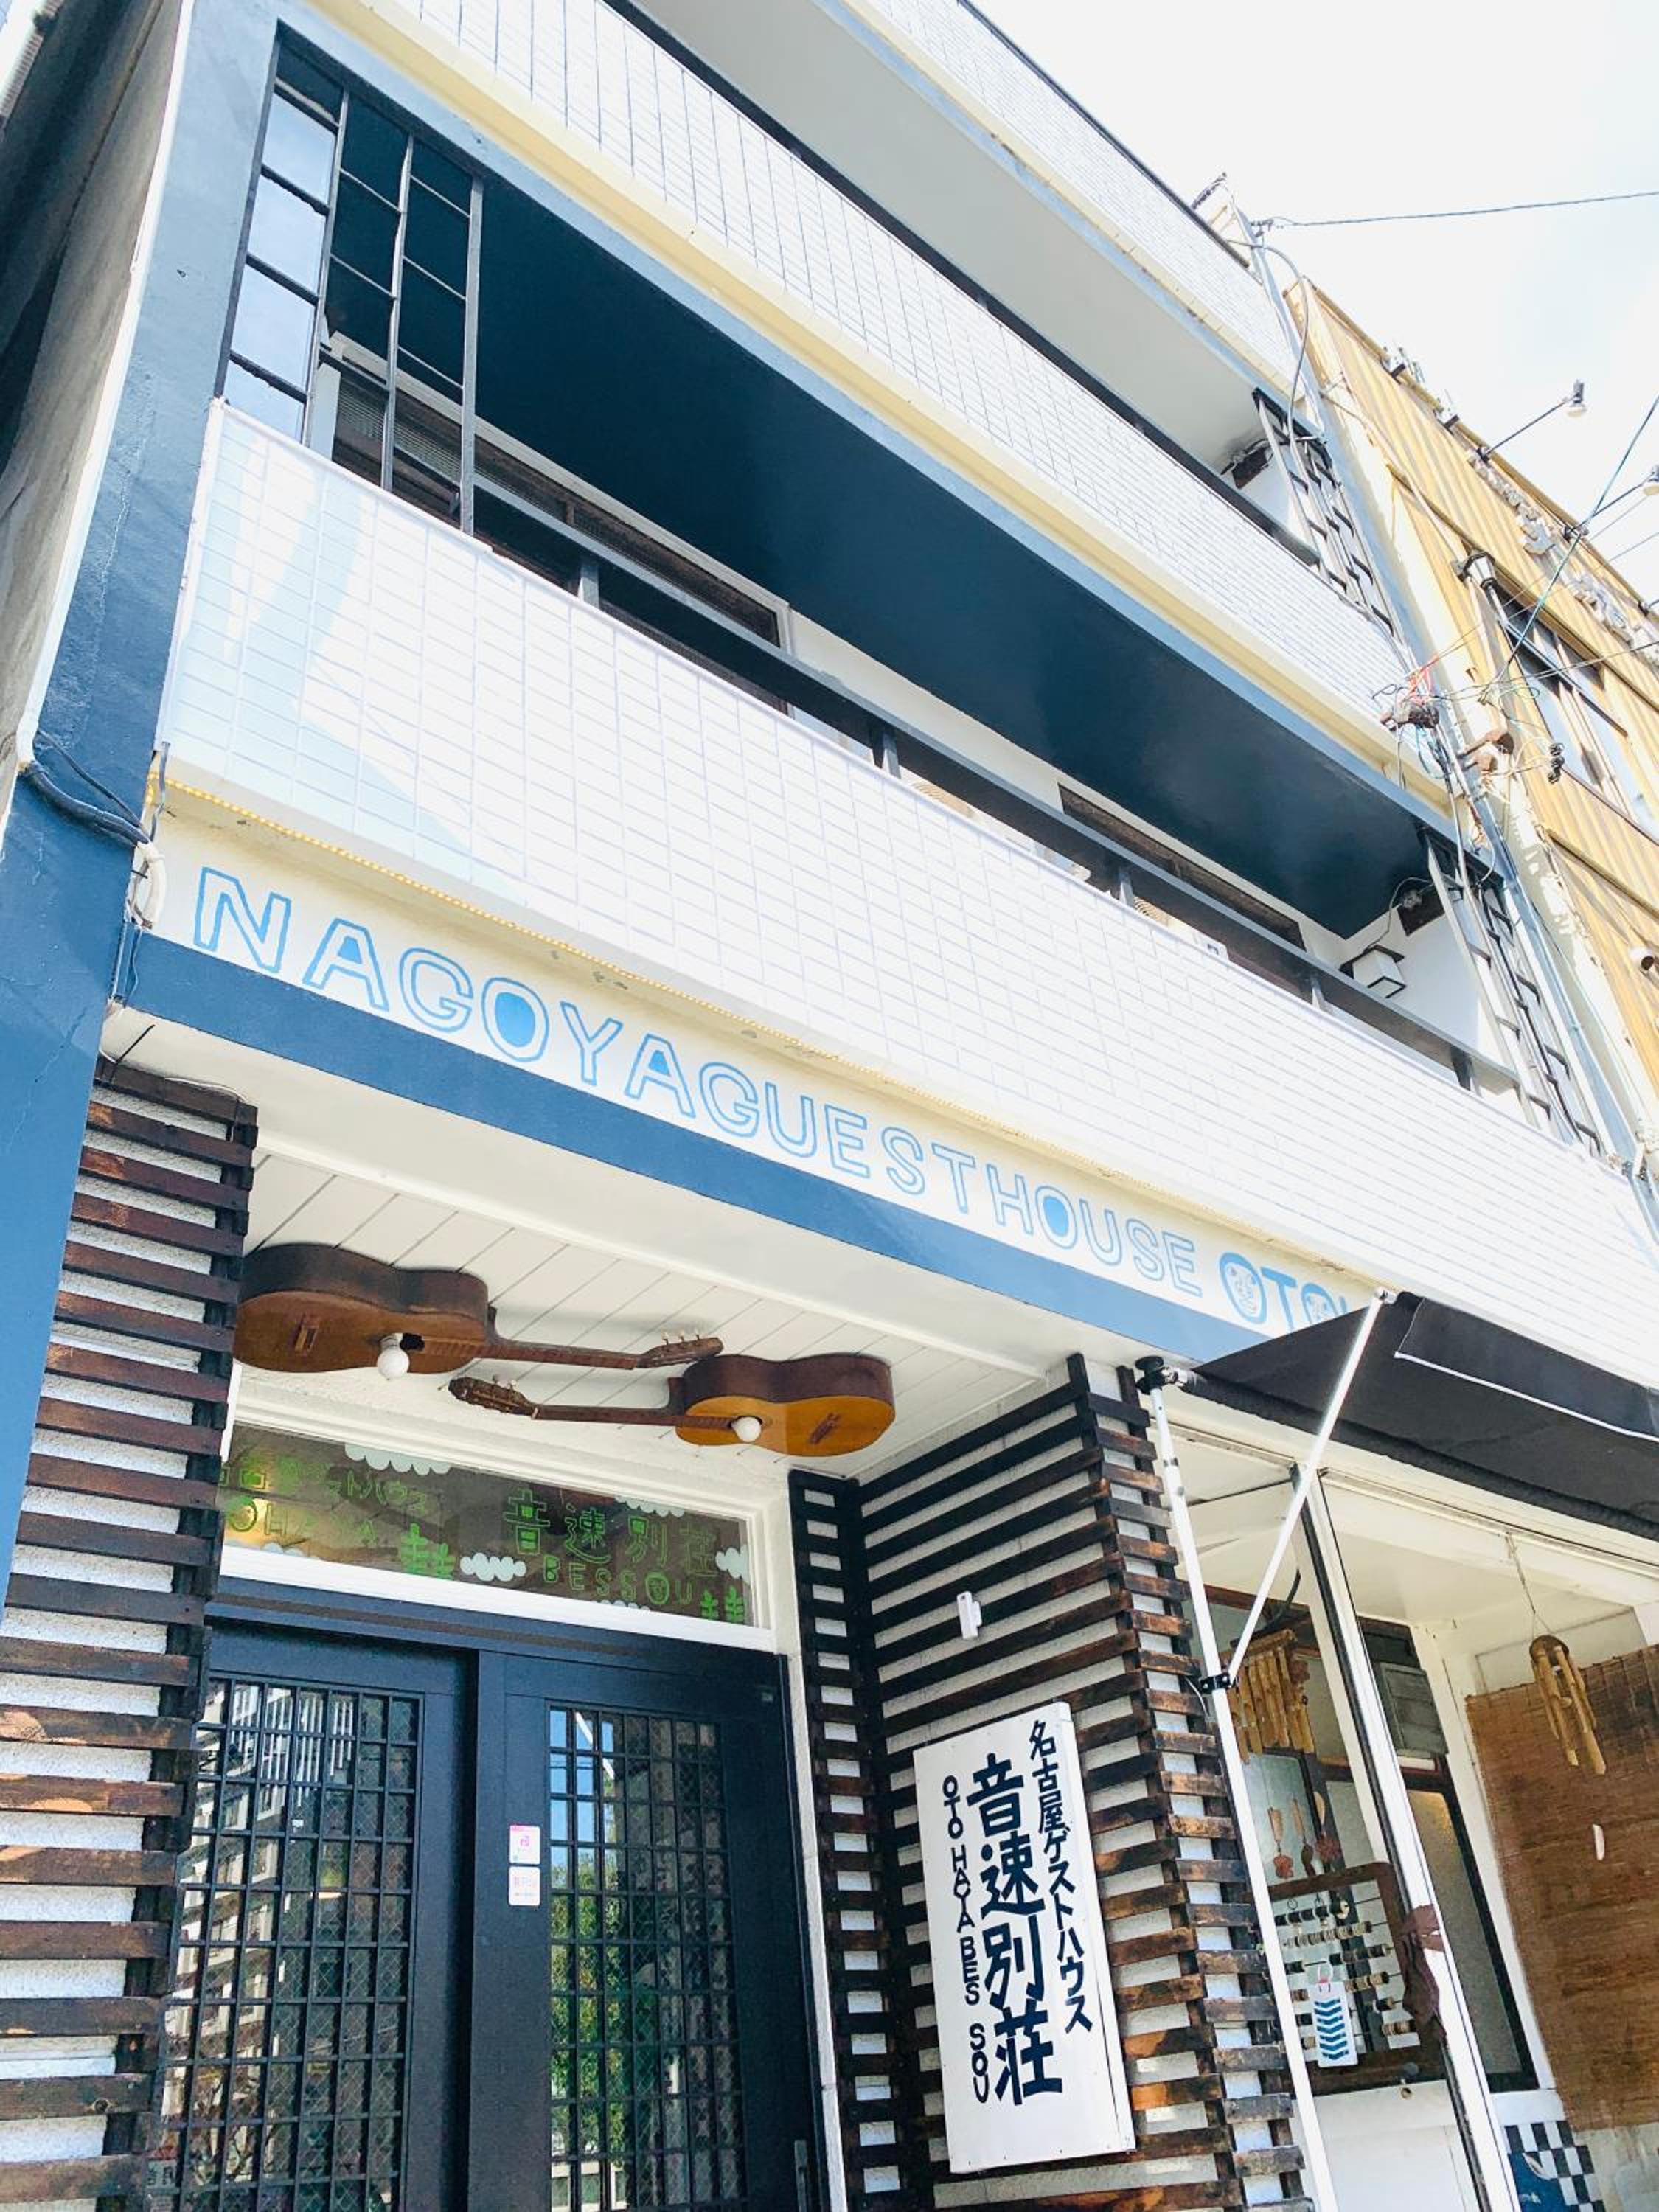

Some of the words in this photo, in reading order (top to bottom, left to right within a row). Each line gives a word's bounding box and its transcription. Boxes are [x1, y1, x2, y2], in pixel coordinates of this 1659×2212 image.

[542, 1554, 694, 1606] BESSOU
[966, 1752, 1062, 2106] 音速別荘
[1029, 1719, 1093, 2035] 名古屋ゲストハウス
